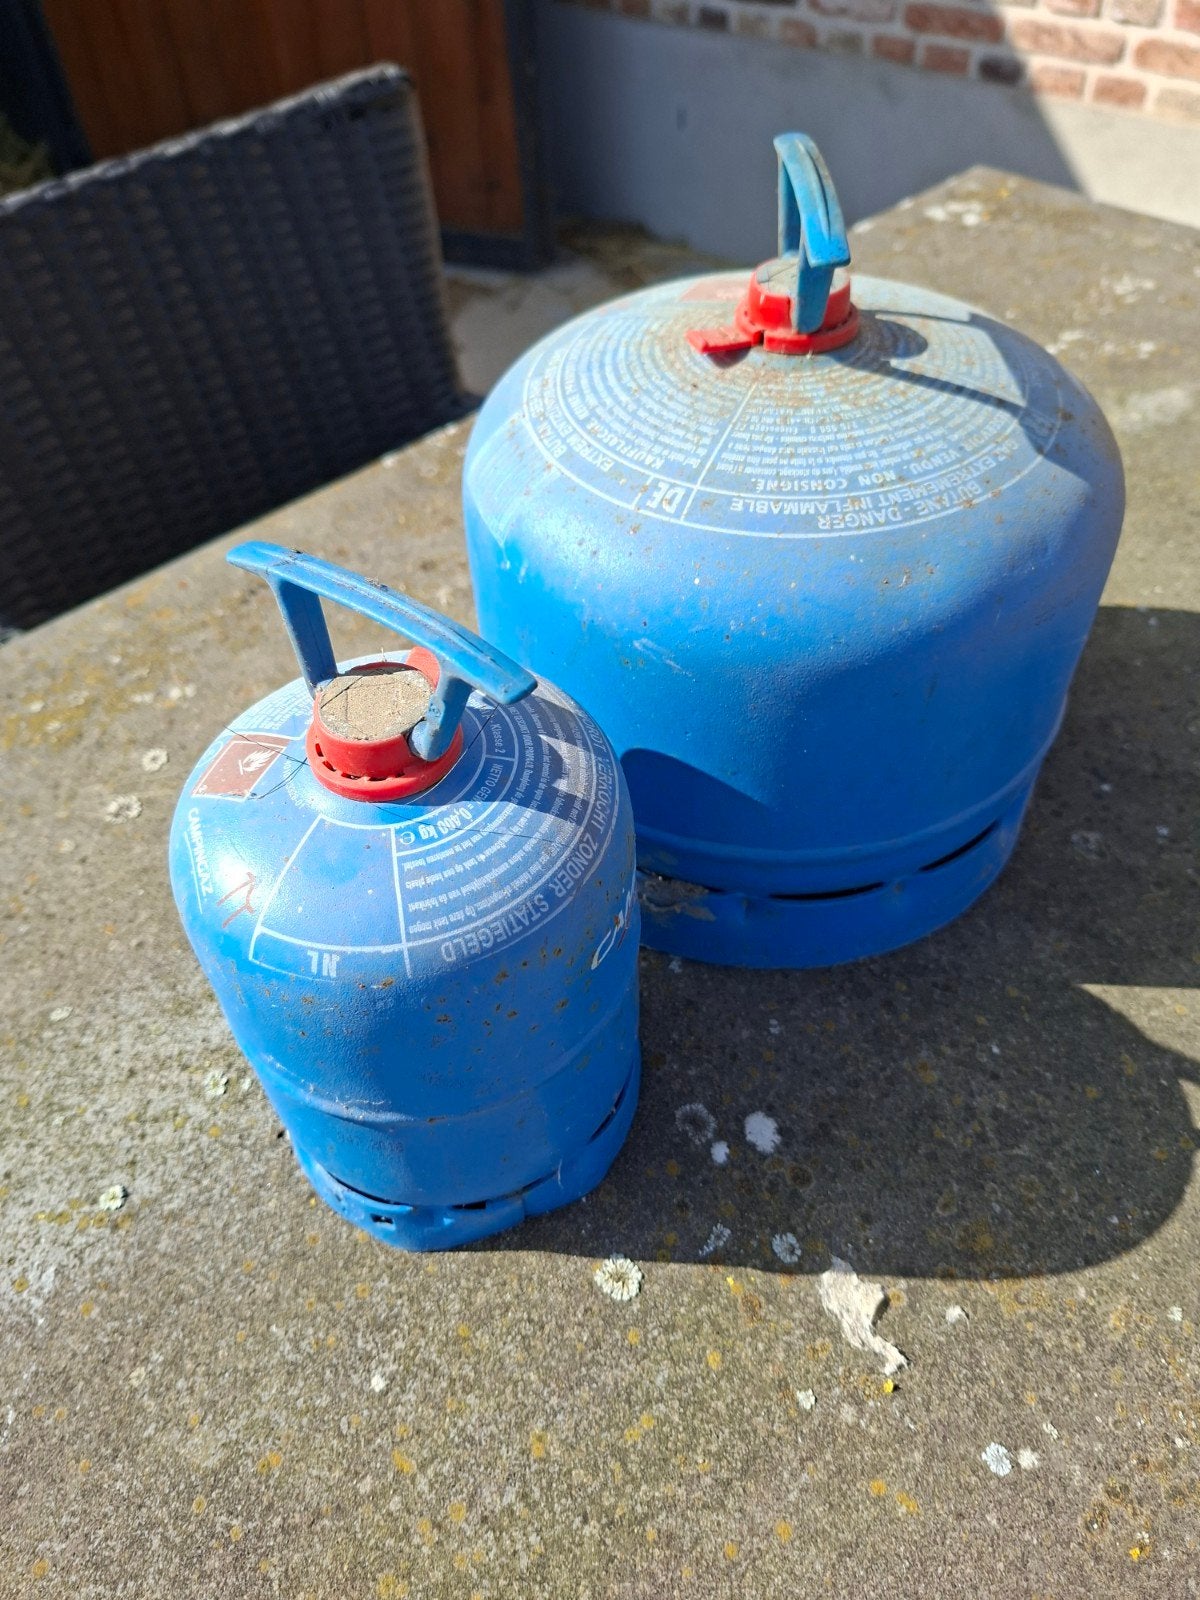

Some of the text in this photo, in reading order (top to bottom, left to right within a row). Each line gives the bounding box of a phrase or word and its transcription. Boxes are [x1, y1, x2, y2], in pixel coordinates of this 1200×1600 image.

[535, 421, 569, 459] BUTAN
[564, 432, 615, 472] EXTREM
[902, 448, 960, 476] VENDU.
[748, 477, 849, 493] CONSIGNÉ.
[857, 469, 897, 486] NON
[875, 455, 996, 506] EXTREMEMENT
[645, 481, 686, 514] DE
[729, 495, 873, 514] INFLAMMABLE
[912, 480, 983, 515] BUTANE
[816, 505, 902, 529] DANGER
[490, 723, 504, 748] Klasse
[494, 746, 505, 755] 2
[484, 762, 503, 788] NETTO
[514, 790, 524, 800] de
[589, 756, 611, 834] VERKOCHT
[516, 815, 529, 829] niet
[417, 820, 438, 843] kg
[470, 831, 483, 843] van
[508, 823, 521, 837] bij
[188, 807, 212, 893] CAMPINGAZ
[452, 843, 462, 853] te
[460, 838, 473, 850] het
[425, 847, 455, 864] monteren
[475, 852, 487, 863] de
[453, 862, 464, 874] op
[462, 856, 478, 871] tank
[547, 832, 599, 899] ZONDER
[424, 872, 443, 885] koele
[442, 867, 456, 878] een
[404, 876, 425, 889] plaats
[438, 894, 448, 904] de
[447, 888, 461, 899] van
[407, 896, 439, 911] fabrikant
[463, 904, 476, 918] Op
[432, 916, 449, 928] tank
[448, 909, 466, 924] deze
[408, 920, 433, 932] mogen
[439, 892, 551, 962] STATIEGELD
[306, 950, 339, 979] NL
